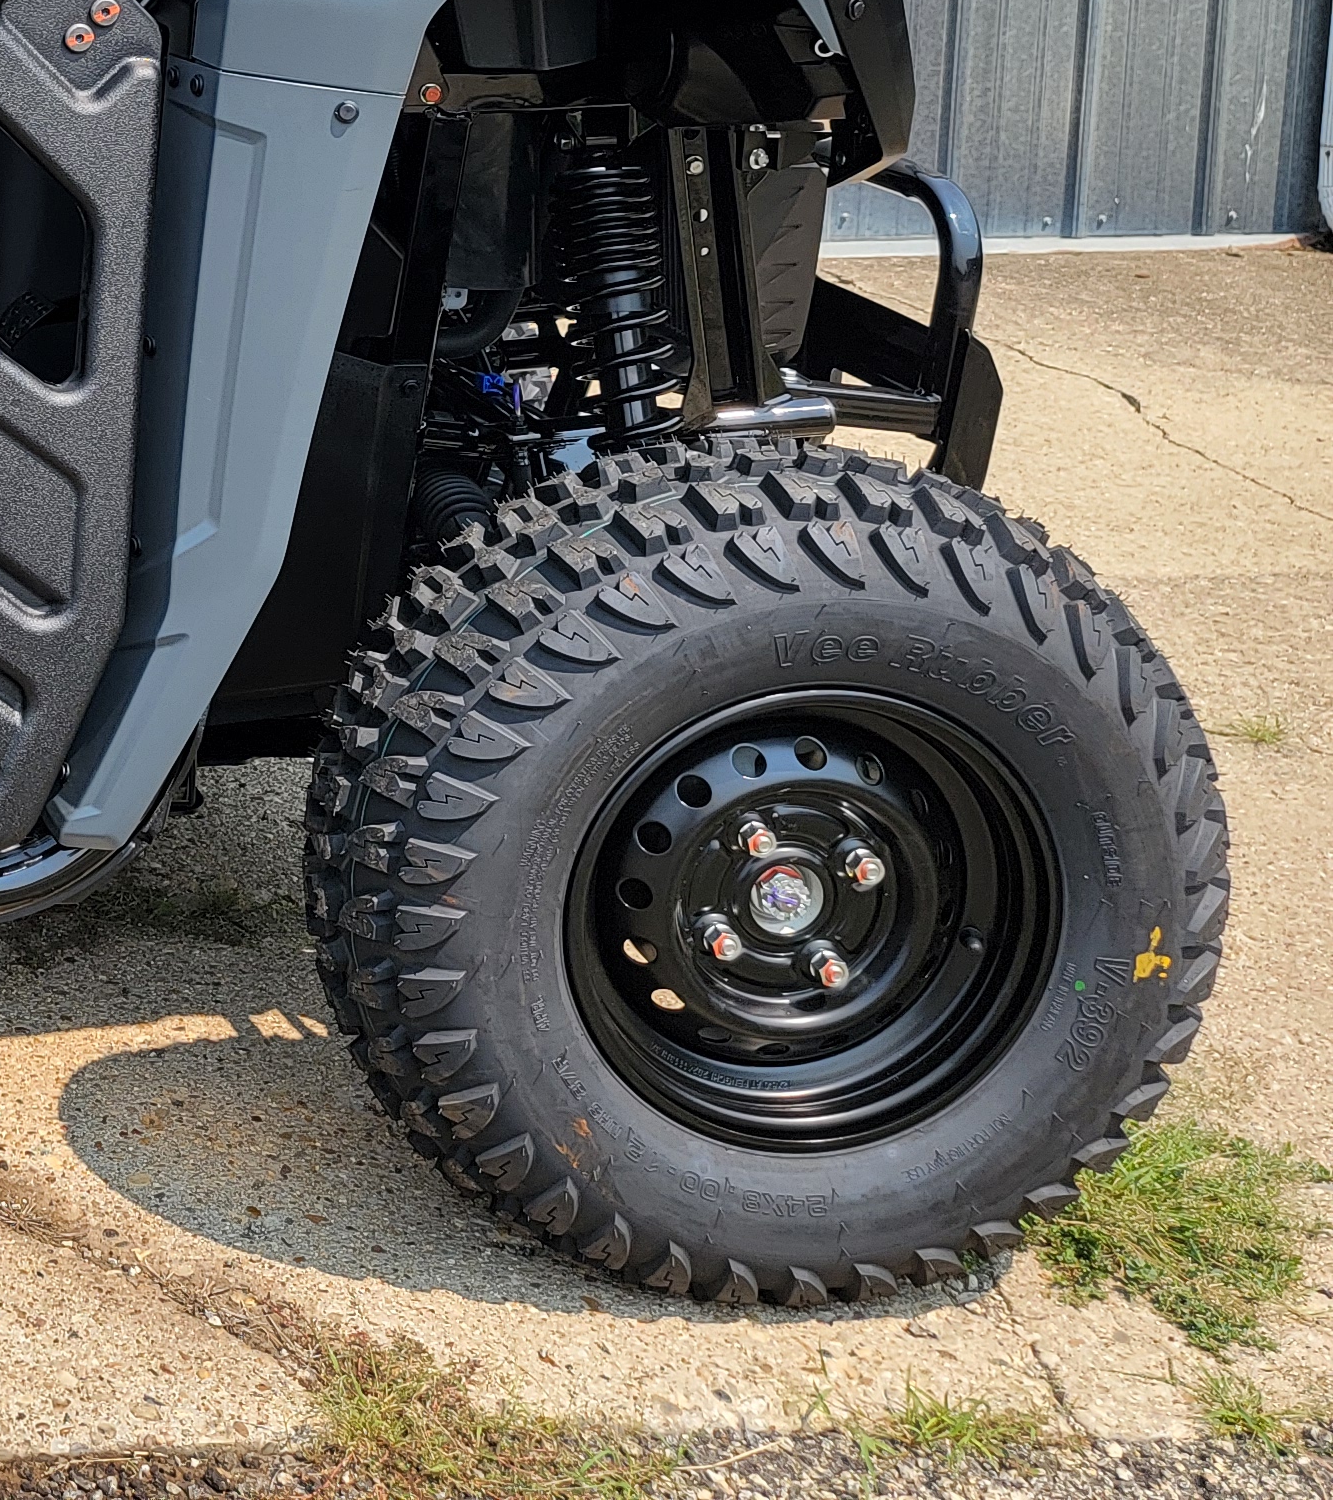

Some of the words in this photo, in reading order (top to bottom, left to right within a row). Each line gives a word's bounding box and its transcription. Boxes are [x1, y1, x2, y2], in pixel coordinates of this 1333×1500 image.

[773, 629, 880, 668] Vee
[889, 633, 1077, 747] Rubber
[1054, 956, 1132, 1072] V-392
